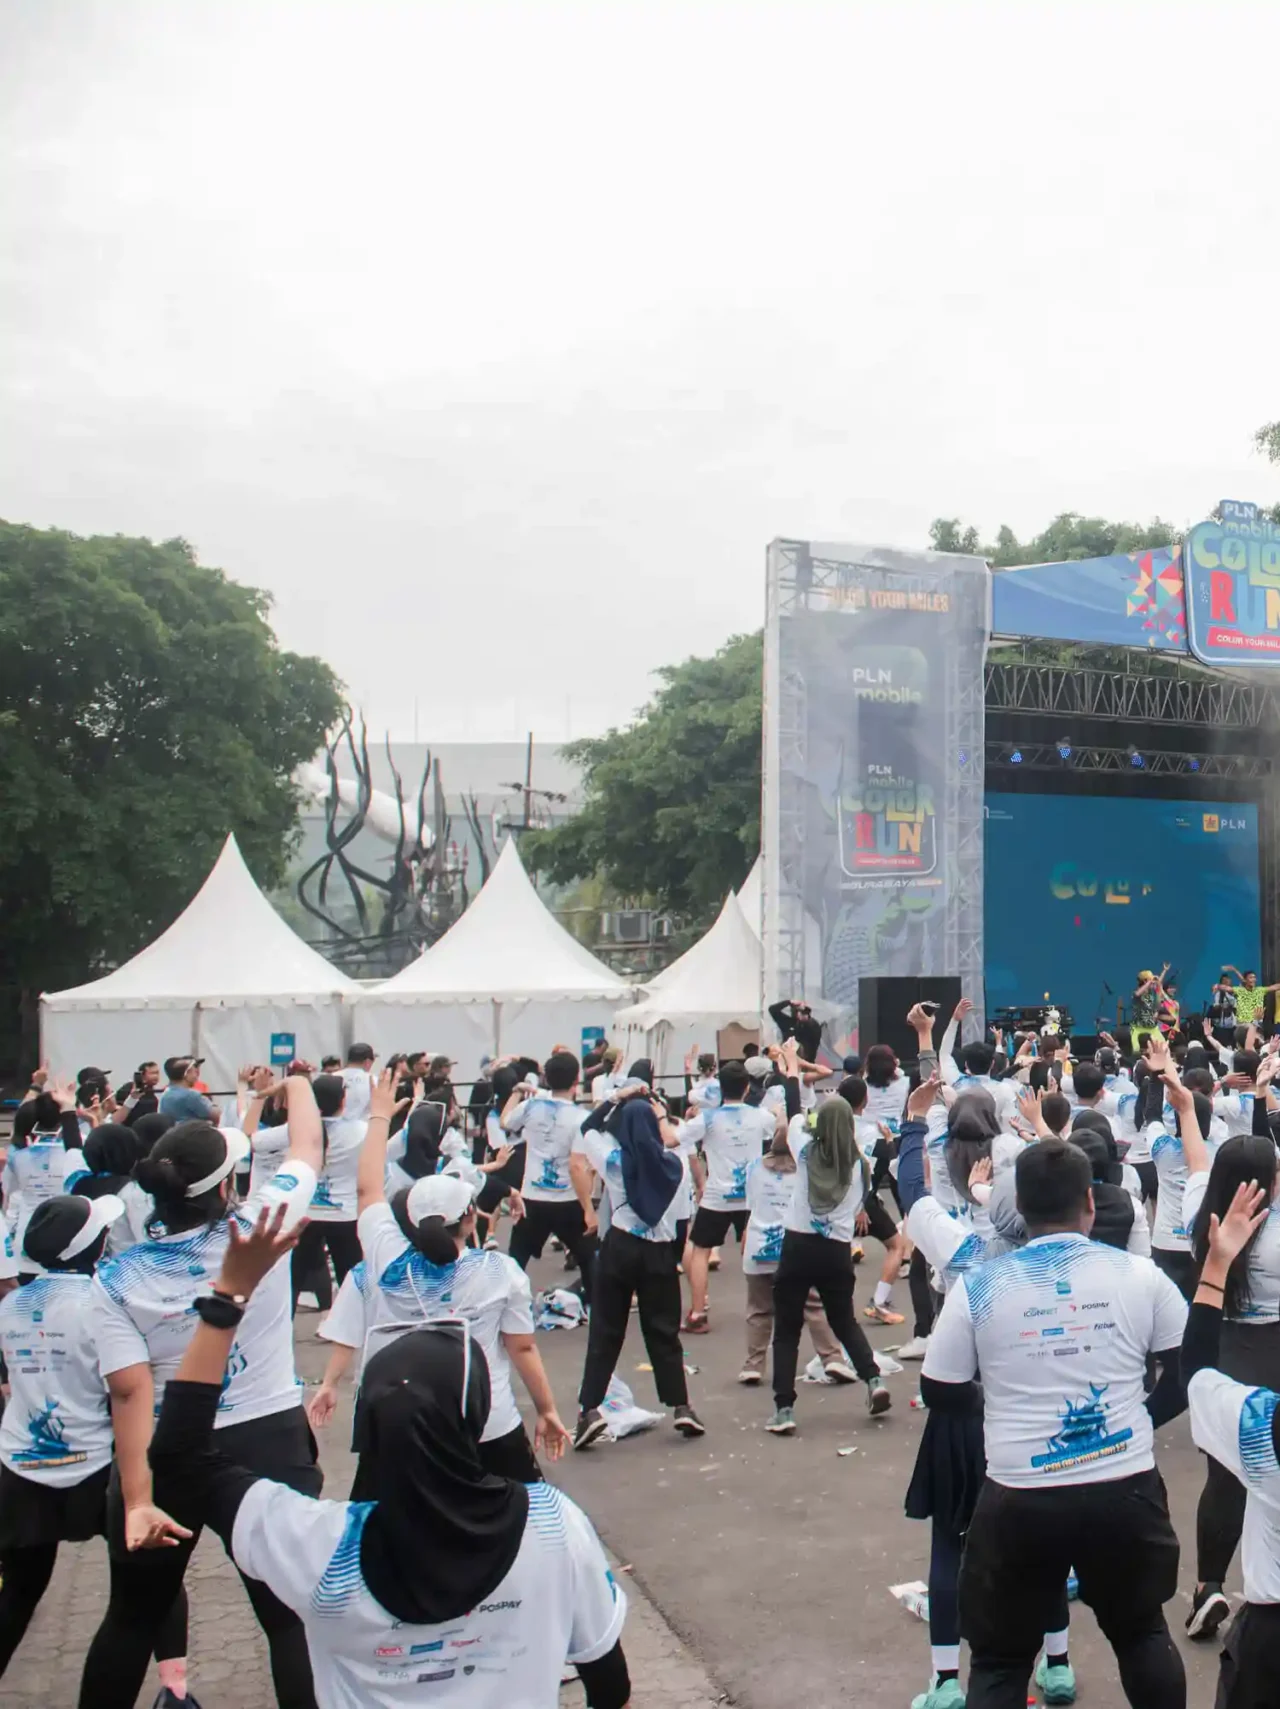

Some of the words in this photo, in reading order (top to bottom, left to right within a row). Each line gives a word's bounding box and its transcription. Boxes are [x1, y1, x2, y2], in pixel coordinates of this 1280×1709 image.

[1224, 503, 1255, 518] PLN
[852, 667, 892, 683] PLN
[854, 686, 922, 704] mobile
[868, 764, 892, 775] PLN
[1220, 819, 1246, 830] PLN
[855, 812, 923, 855] RUN
[479, 1600, 522, 1613] POSPAY
